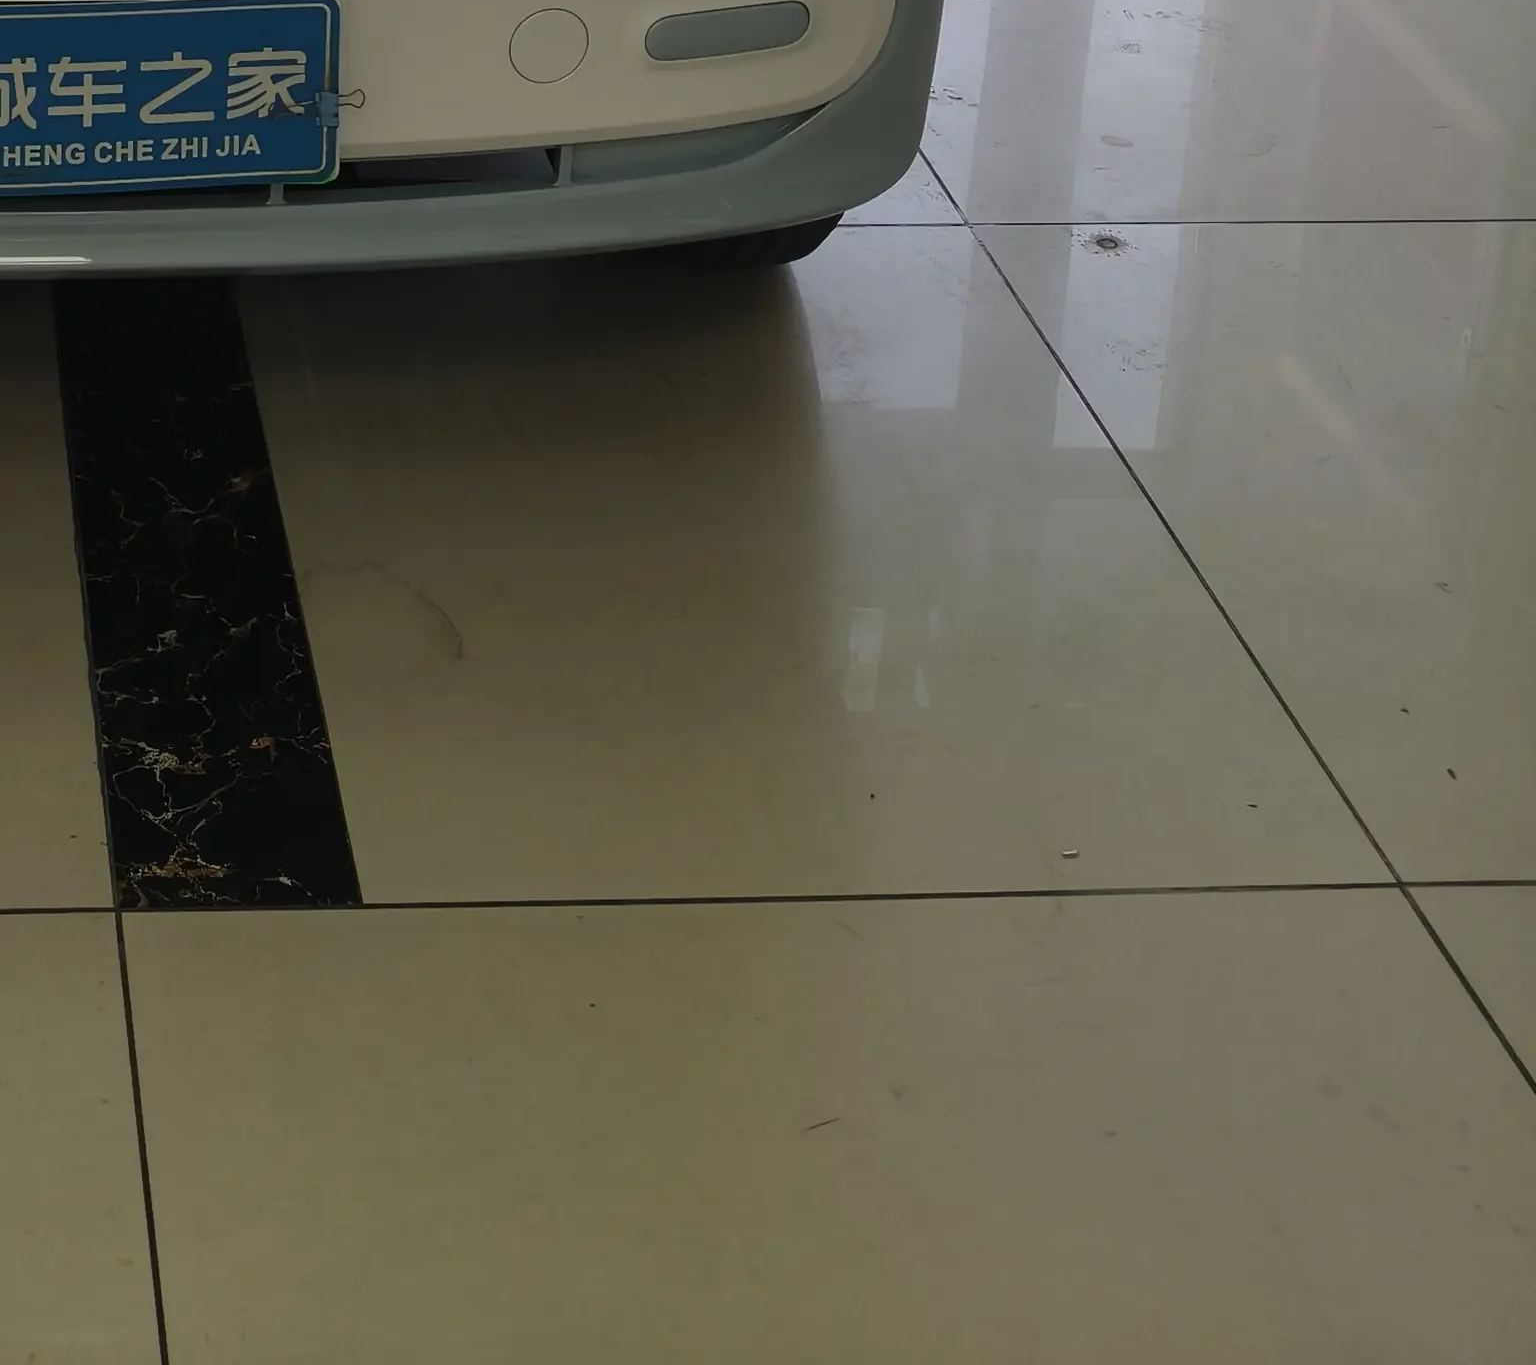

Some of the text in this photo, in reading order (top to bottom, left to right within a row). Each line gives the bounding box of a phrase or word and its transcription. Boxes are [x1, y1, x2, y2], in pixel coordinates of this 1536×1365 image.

[93, 139, 155, 162] CHE
[161, 137, 210, 160] ZHI
[216, 134, 263, 157] JIA
